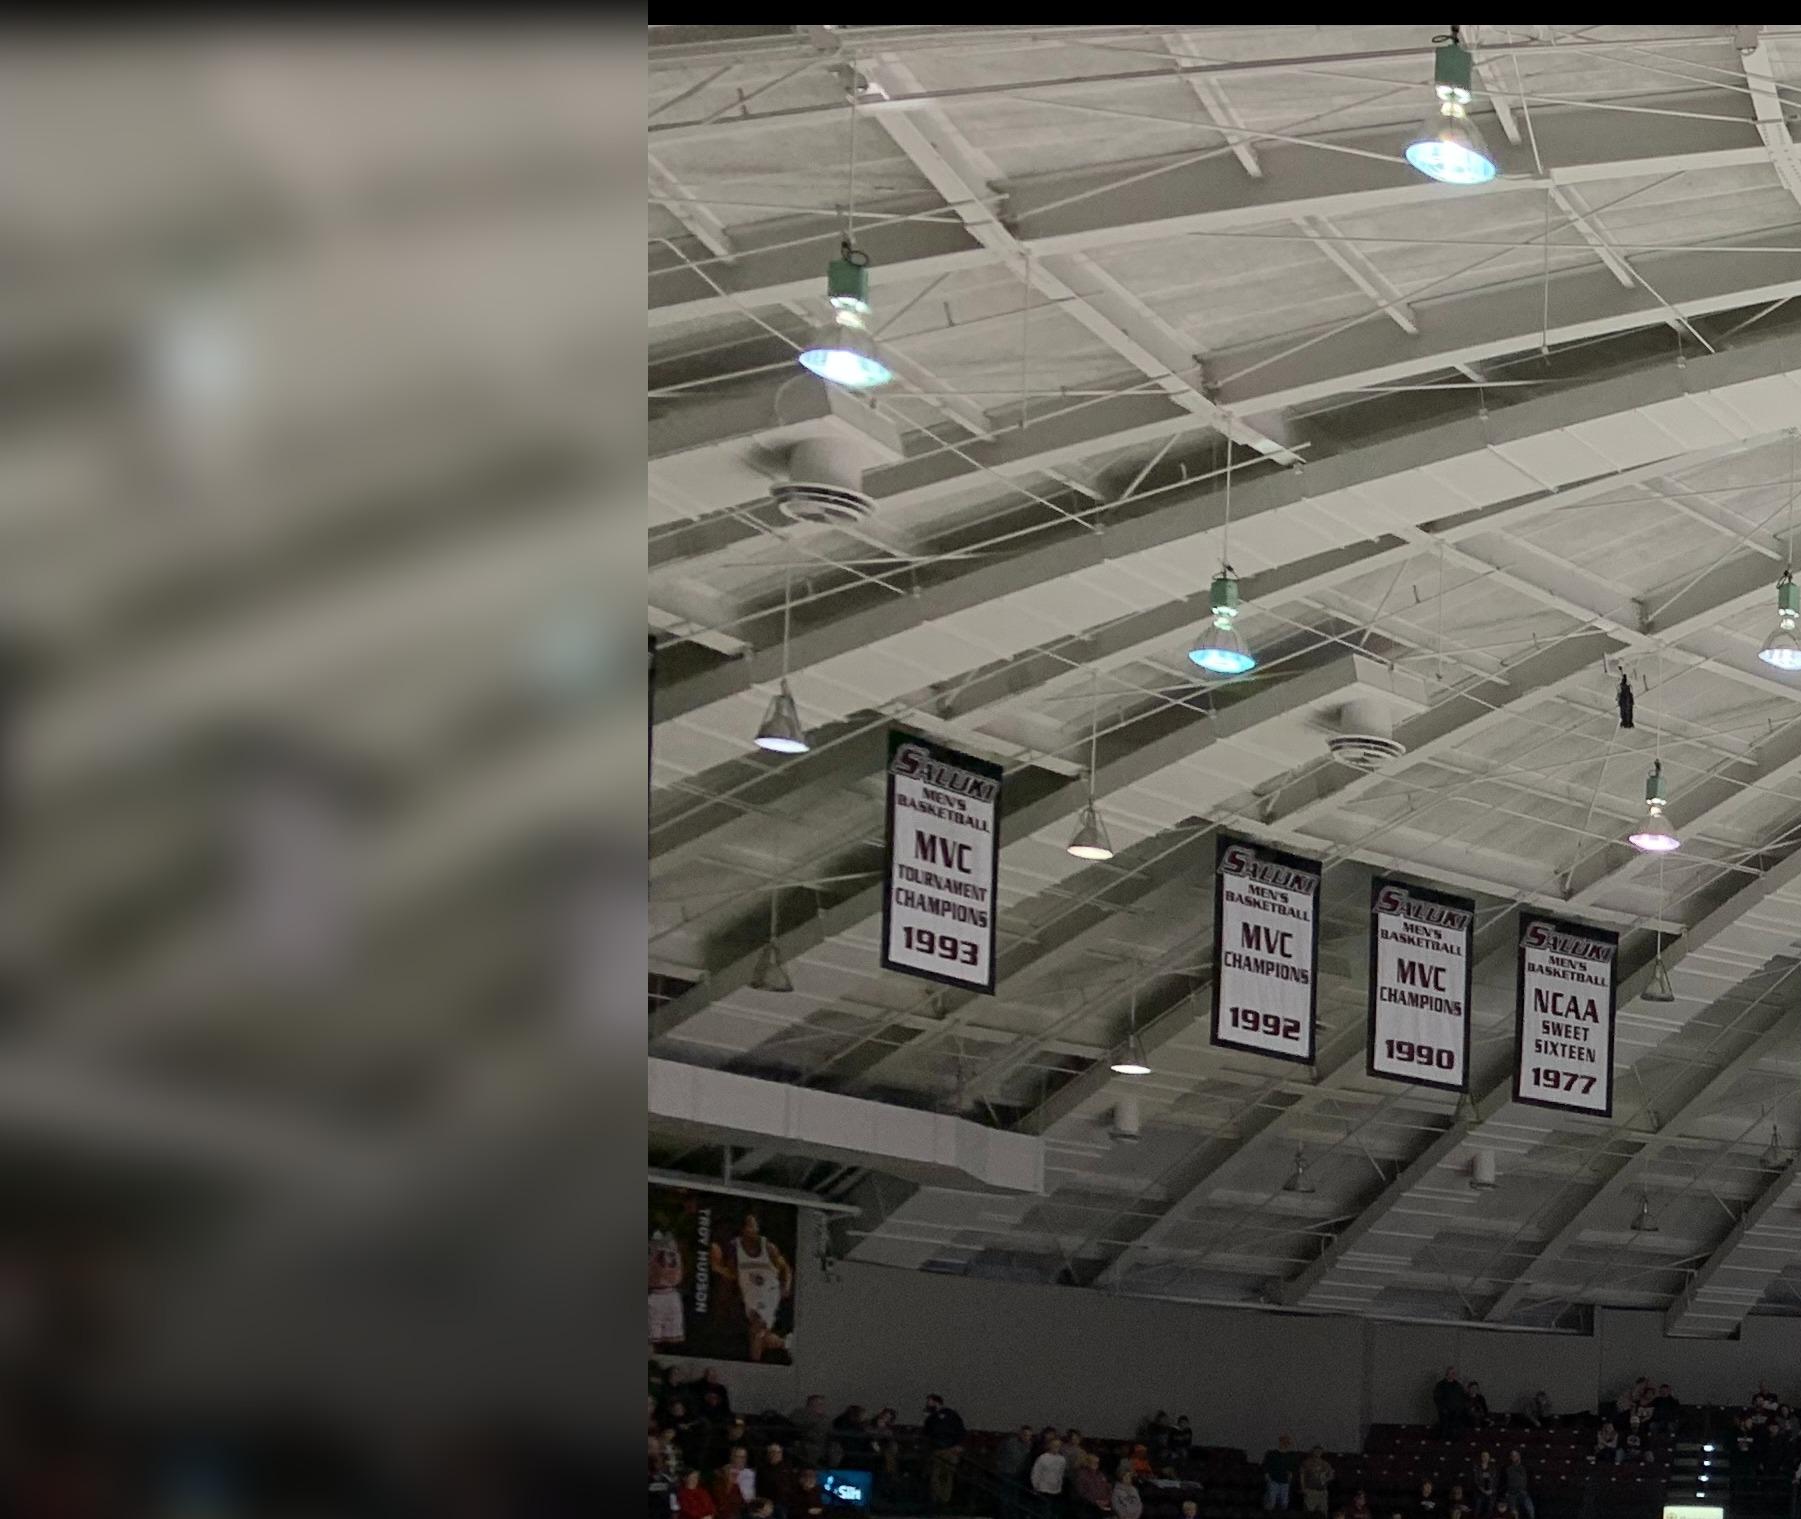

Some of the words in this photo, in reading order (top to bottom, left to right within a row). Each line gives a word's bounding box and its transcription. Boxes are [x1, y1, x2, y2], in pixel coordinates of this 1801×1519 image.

[894, 746, 998, 801] SALUKI
[897, 793, 990, 833] BASKETBALL
[922, 787, 966, 811] MEN'S
[915, 830, 972, 874] MVC
[899, 864, 987, 902] TOURNAMENT
[1248, 884, 1289, 904] MEN'S
[896, 888, 988, 928] CHAMPIONS
[1225, 891, 1310, 922] BASKETBALL
[903, 926, 978, 966] 1993
[1241, 922, 1293, 959] MVC
[1380, 928, 1462, 956] BASKETBALL
[1402, 922, 1442, 940] MEN'S
[1224, 951, 1309, 985] CHAMPIONS
[1397, 958, 1446, 992] MVC
[1527, 962, 1608, 987] BASKETBALL
[1548, 955, 1587, 972] MEN'S
[1380, 986, 1462, 1016] CHAMPIONS
[1534, 988, 1599, 1023] NCAA
[1229, 1007, 1301, 1041] 1992
[1542, 1020, 1590, 1042] SWEET
[1385, 1039, 1455, 1070] 1990
[1535, 1039, 1596, 1063] SIXTEEN
[1531, 1067, 1597, 1094] 1977
